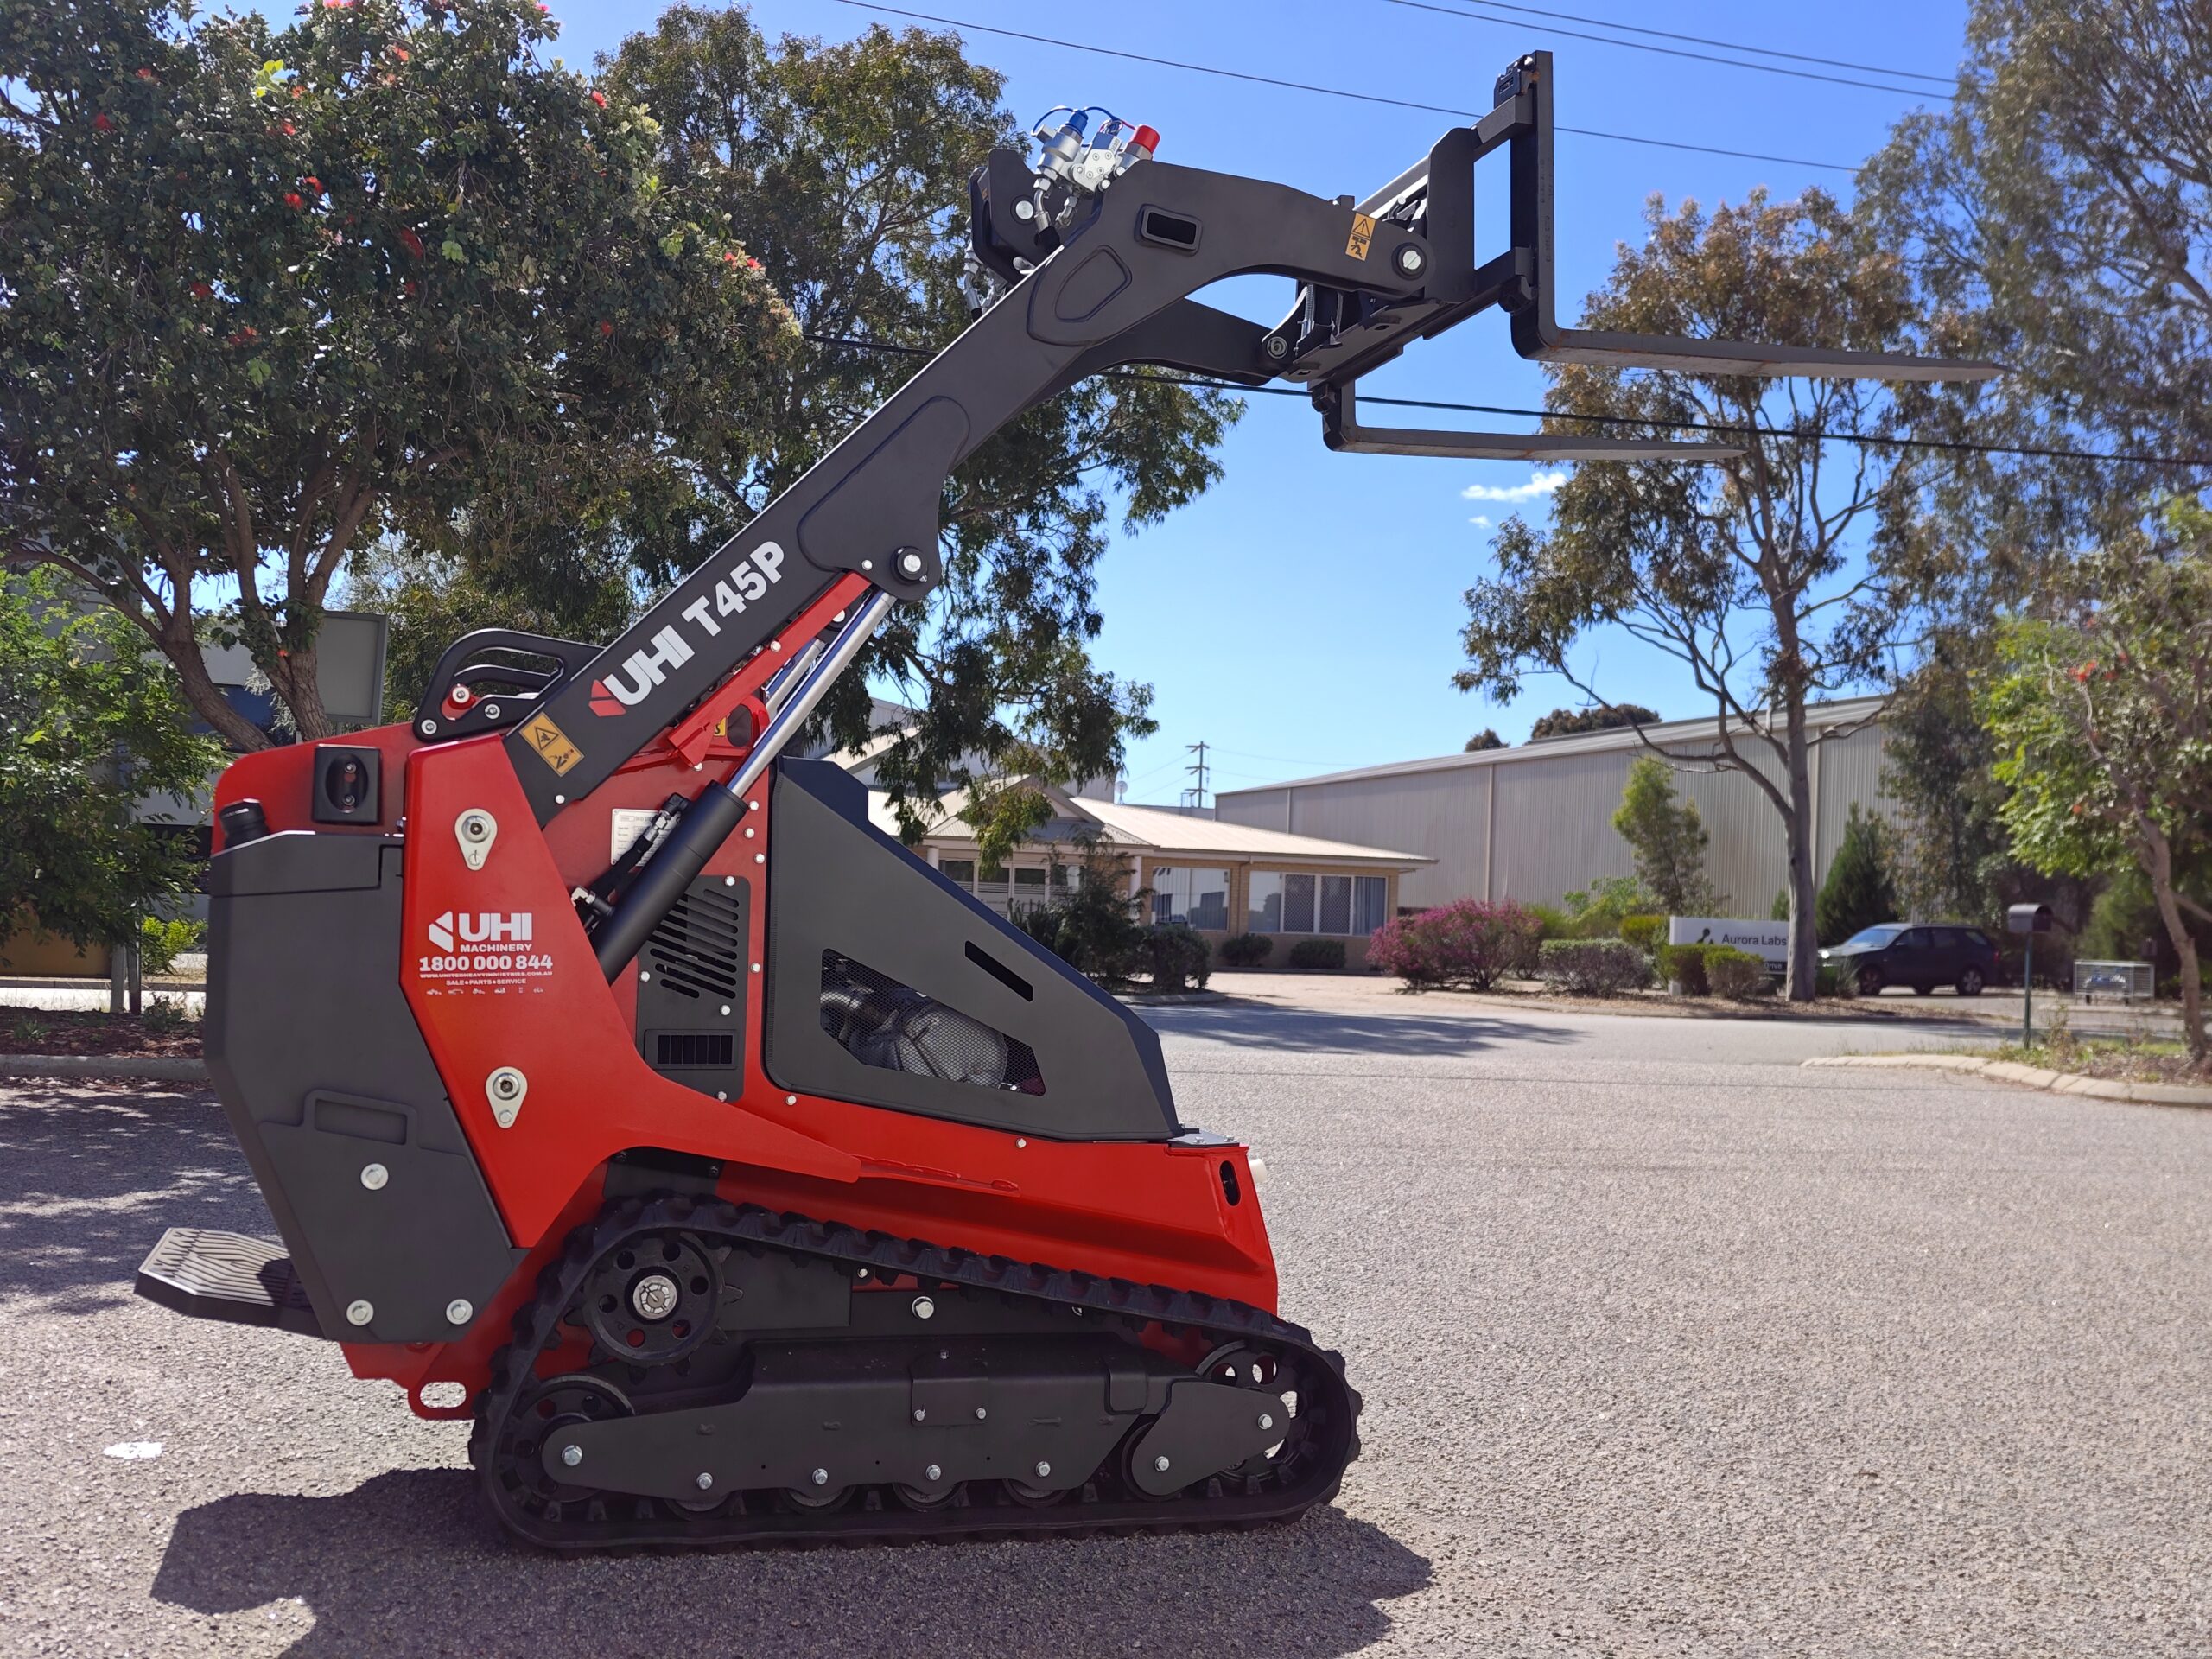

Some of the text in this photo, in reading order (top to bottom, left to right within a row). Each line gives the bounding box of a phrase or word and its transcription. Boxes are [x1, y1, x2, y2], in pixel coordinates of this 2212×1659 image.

[603, 540, 785, 706] UHI T45P
[459, 912, 531, 942] UHI
[461, 944, 531, 952] MACHINERY
[1721, 934, 1787, 946] Aurora Labs
[419, 955, 553, 971] 1800 000 844
